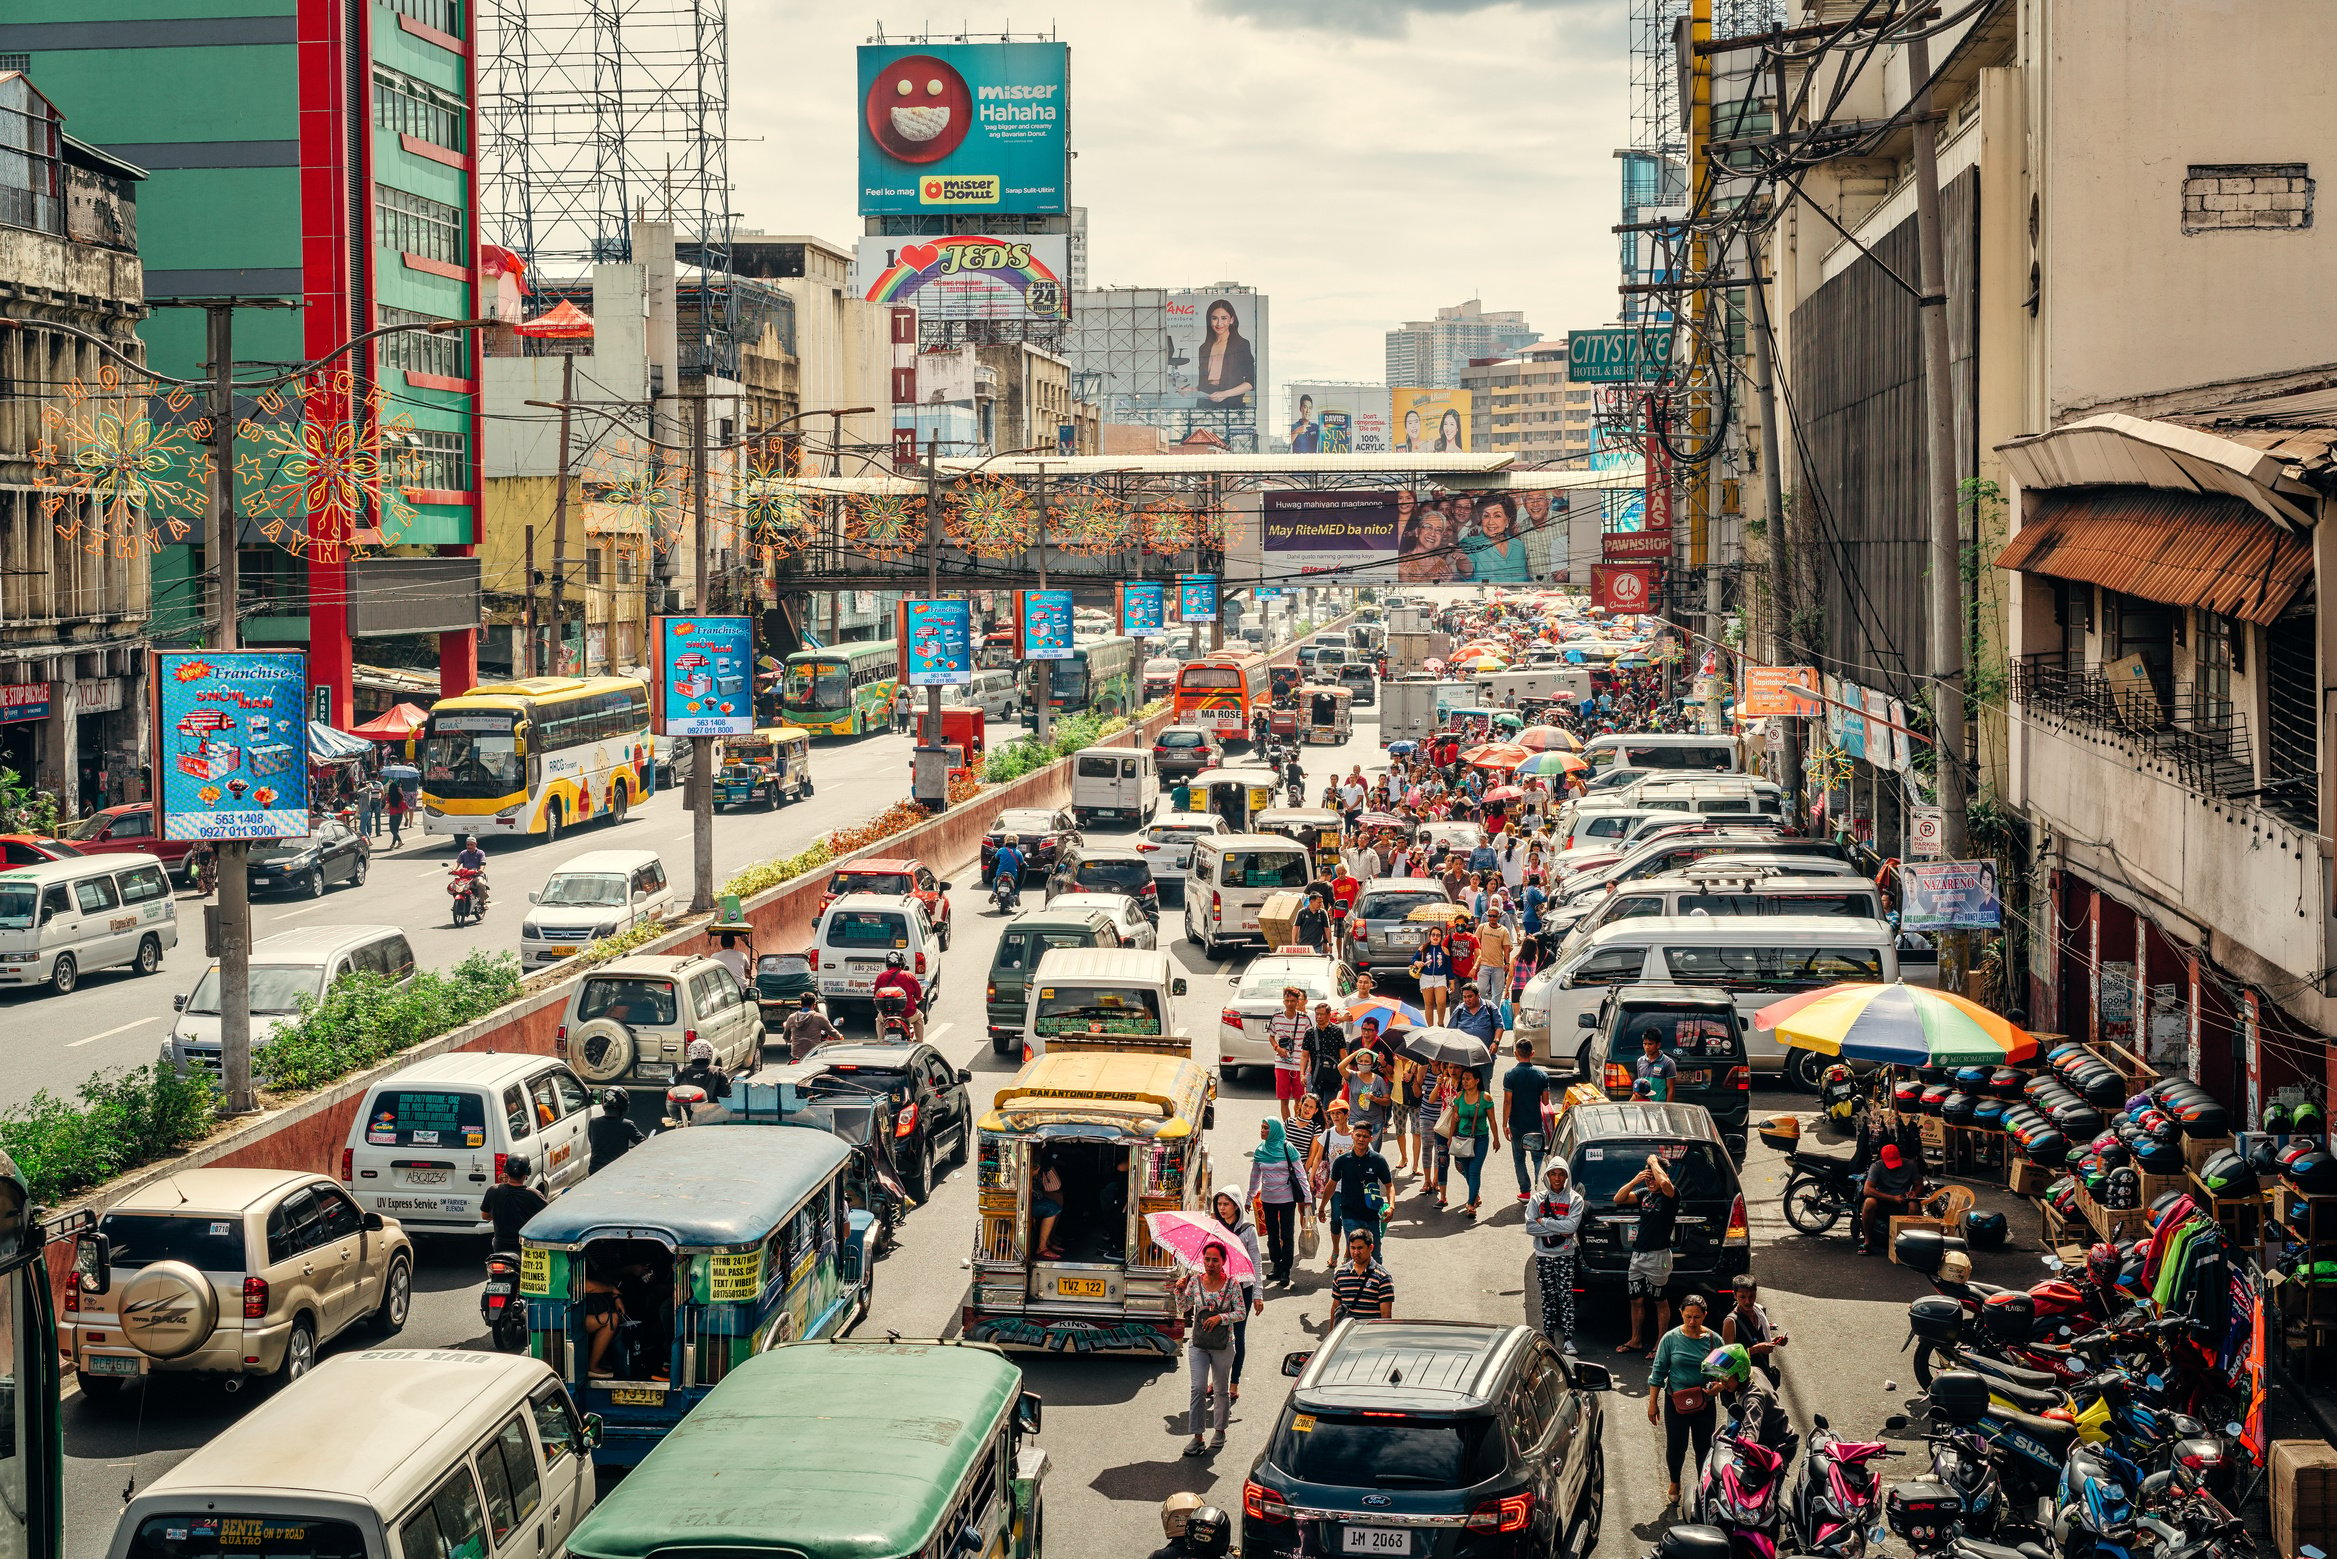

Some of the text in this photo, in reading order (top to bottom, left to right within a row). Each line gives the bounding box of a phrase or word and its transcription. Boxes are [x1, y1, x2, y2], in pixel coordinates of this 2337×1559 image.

[978, 84, 1057, 100] mister
[980, 102, 1056, 121] Hahaha
[944, 180, 994, 190] mister
[865, 188, 915, 197] Feel ko mag
[944, 189, 994, 199] Donut
[885, 242, 1031, 275] I JED'S
[1032, 289, 1057, 304] 24
[1033, 304, 1055, 312] HOURS
[1573, 366, 1611, 377] HOTEL &
[1324, 414, 1345, 423] DAVIES
[1325, 429, 1346, 441] SUN
[1323, 441, 1349, 453] RAIN
[1355, 443, 1385, 451] ACRYLIC
[1276, 501, 1301, 509] Huwag
[1268, 523, 1393, 538] May RiteMED ba nito?
[1604, 537, 1671, 552] PAWNSHOP
[697, 625, 741, 635] Franchise
[180, 664, 206, 679] New!
[214, 666, 288, 680] Franchise
[9, 683, 49, 705] STOP BICYCLE
[195, 684, 246, 702] SNOW
[238, 697, 274, 709] MAN
[1200, 710, 1215, 719] MA
[1217, 710, 1241, 719] ROSE
[439, 722, 459, 730] GMA
[704, 726, 716, 734] 011
[215, 813, 264, 825] 563 1408
[200, 825, 277, 838] 0927 011 8000
[1922, 877, 1975, 891] NAZARENO
[1950, 1054, 1994, 1063] MICROMATIC
[1028, 1089, 1137, 1101] SAN ANTONIO SPURS
[405, 1171, 447, 1183] ABQ1236
[376, 1197, 438, 1210] UV Express Service
[440, 1198, 467, 1206] SM FAIRVIEW
[531, 1250, 545, 1260] 1342
[534, 1261, 543, 1270] 23
[732, 1256, 745, 1266] 24/7
[712, 1267, 744, 1277] MAX. PASS.
[712, 1278, 728, 1288] TEXT
[1062, 1281, 1101, 1292] TWZ 122
[2004, 1304, 2025, 1313] PLAYBOY
[150, 1316, 187, 1324] RAV4
[1058, 1320, 1088, 1328] KING
[964, 1316, 1178, 1353] ARTHUR
[1369, 1496, 1386, 1505] Ford
[204, 1518, 219, 1528] 24
[220, 1519, 264, 1536] BENTE
[263, 1529, 274, 1539] ON
[284, 1529, 305, 1540] ROAD
[219, 1535, 262, 1546] QUATRO
[1372, 1533, 1402, 1548] 2063
